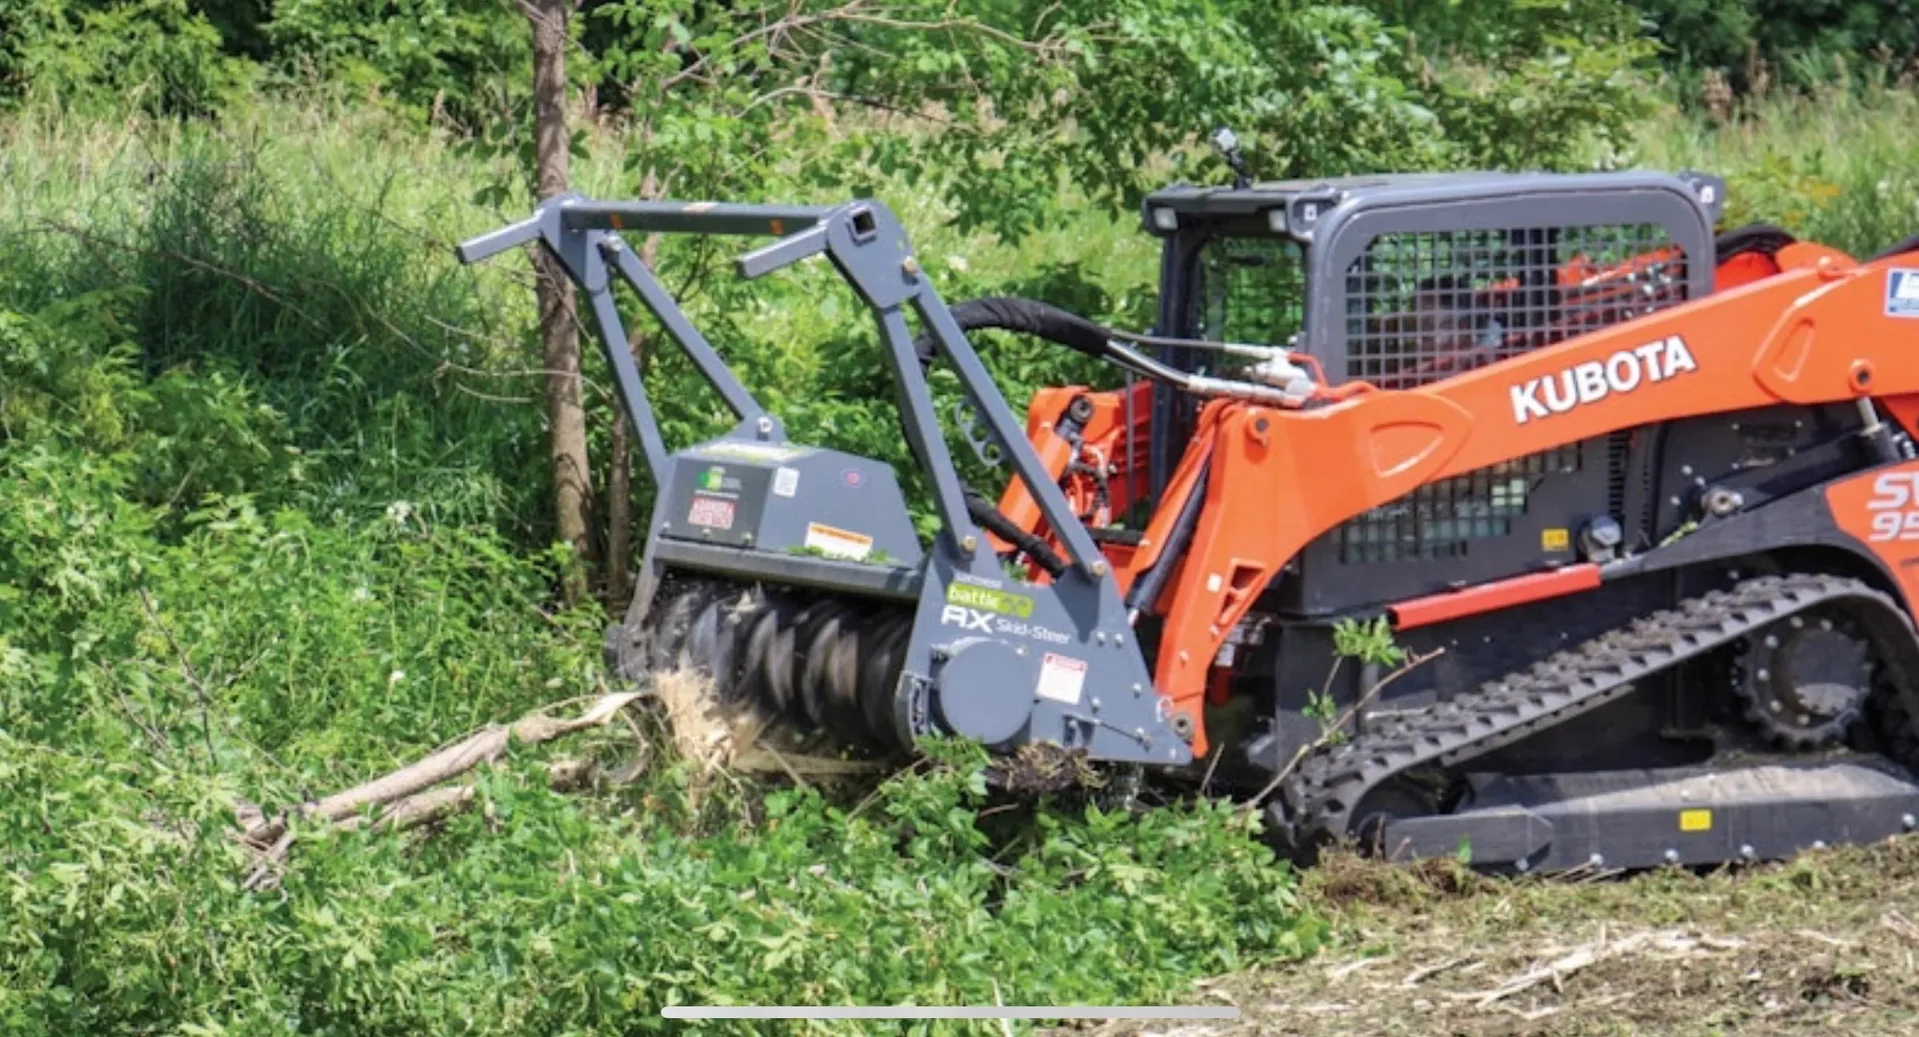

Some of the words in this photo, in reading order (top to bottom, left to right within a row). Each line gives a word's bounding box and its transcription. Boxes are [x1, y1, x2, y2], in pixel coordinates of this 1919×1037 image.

[1509, 335, 1696, 424] KUBOTA
[1866, 472, 1919, 509] S
[949, 583, 1000, 610] battle
[941, 604, 996, 634] AX
